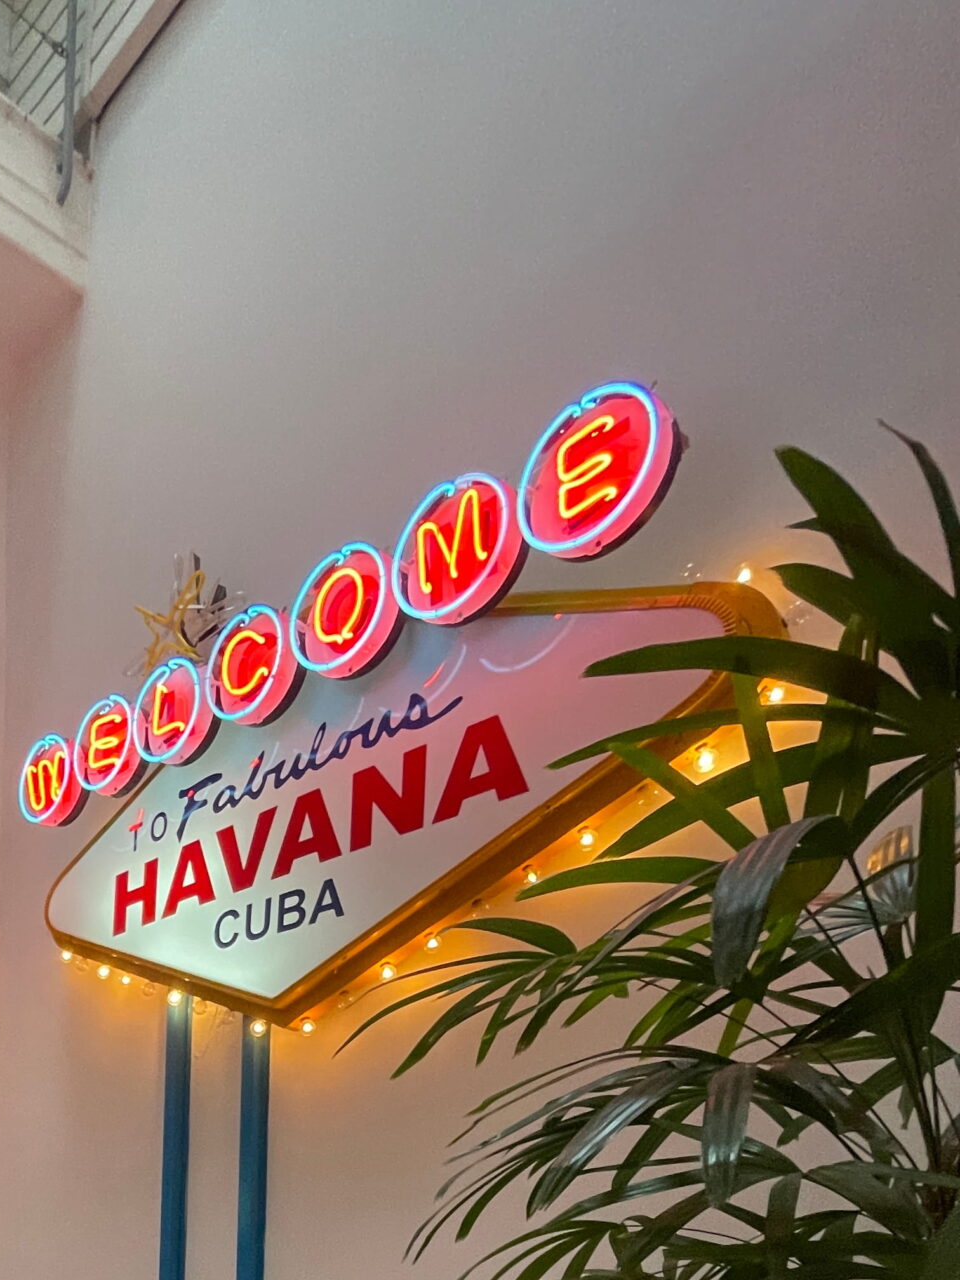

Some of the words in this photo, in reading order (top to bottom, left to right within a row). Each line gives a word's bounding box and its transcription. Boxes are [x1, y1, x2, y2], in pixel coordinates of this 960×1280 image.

[26, 415, 630, 812] WELCOME
[112, 714, 530, 936] HAVANA
[128, 811, 168, 852] TO
[177, 692, 463, 844] Fabulous
[214, 878, 345, 949] CUBA
